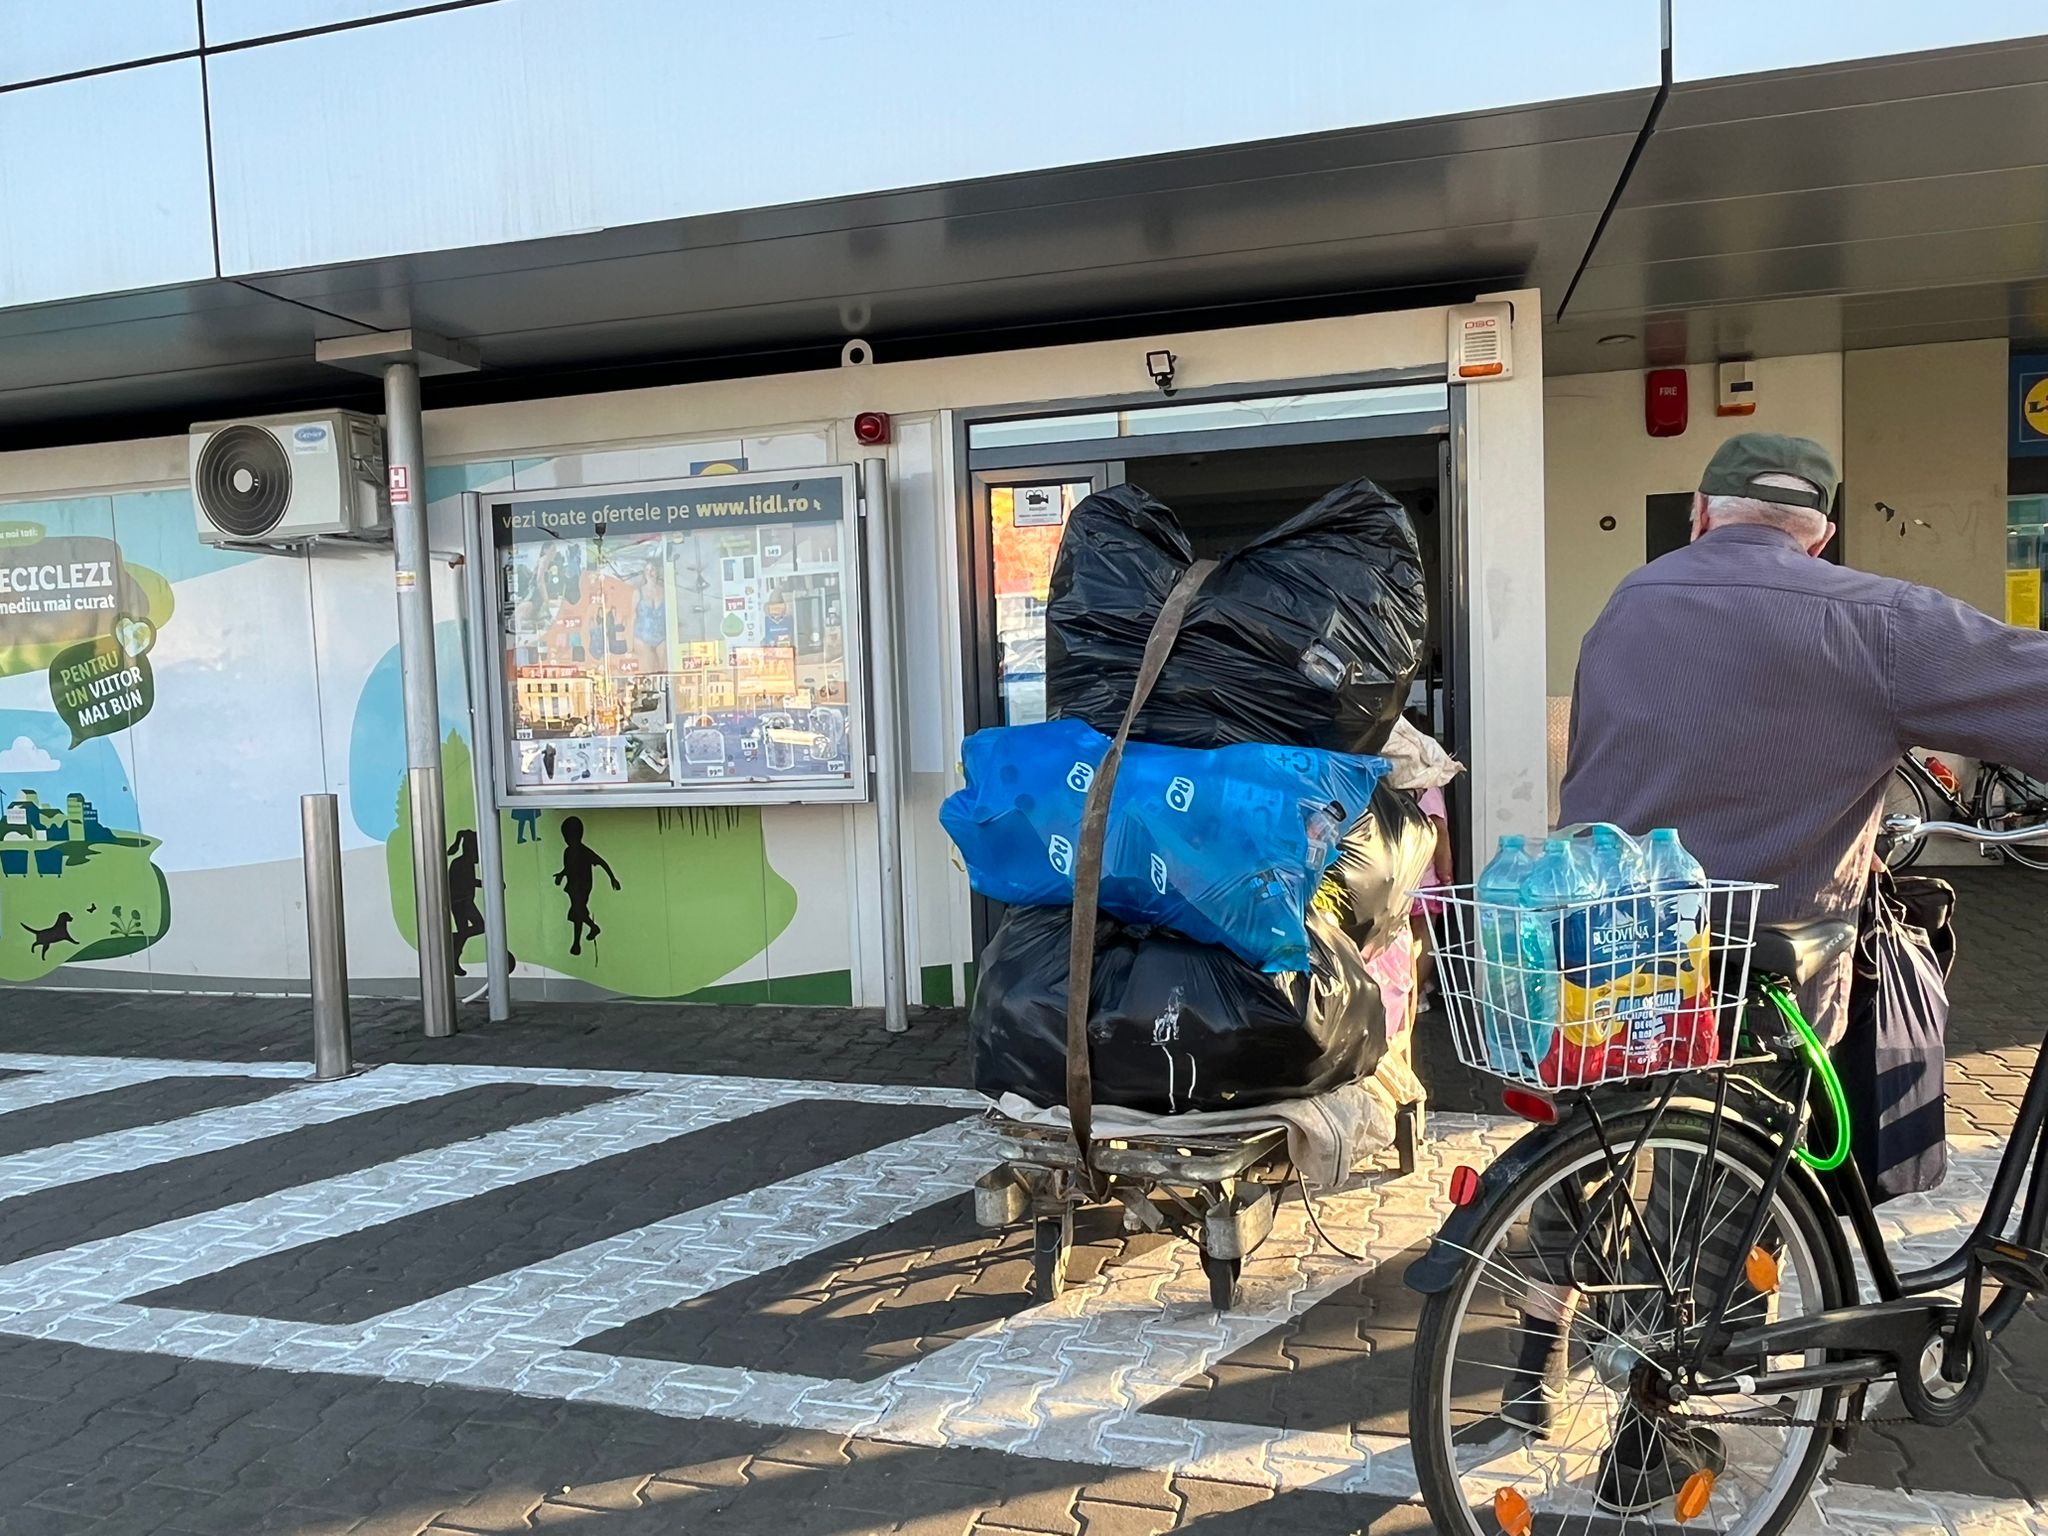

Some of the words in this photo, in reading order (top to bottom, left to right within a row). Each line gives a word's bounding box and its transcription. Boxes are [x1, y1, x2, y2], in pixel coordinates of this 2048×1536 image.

[1465, 319, 1496, 329] DSC
[1659, 386, 1678, 396] FIRE
[502, 510, 536, 529] vezi
[542, 509, 587, 527] toate
[592, 502, 661, 524] ofertele
[667, 504, 690, 524] pe
[696, 494, 809, 518] www.lidl.ro
[0, 561, 113, 594] ECICLEZI
[44, 594, 71, 612] mai
[74, 593, 116, 610] curat
[60, 650, 119, 687] PENTRU
[65, 686, 89, 708] UN
[88, 666, 143, 699] VIITOR
[78, 702, 110, 727] MAI
[109, 688, 144, 715] BUN
